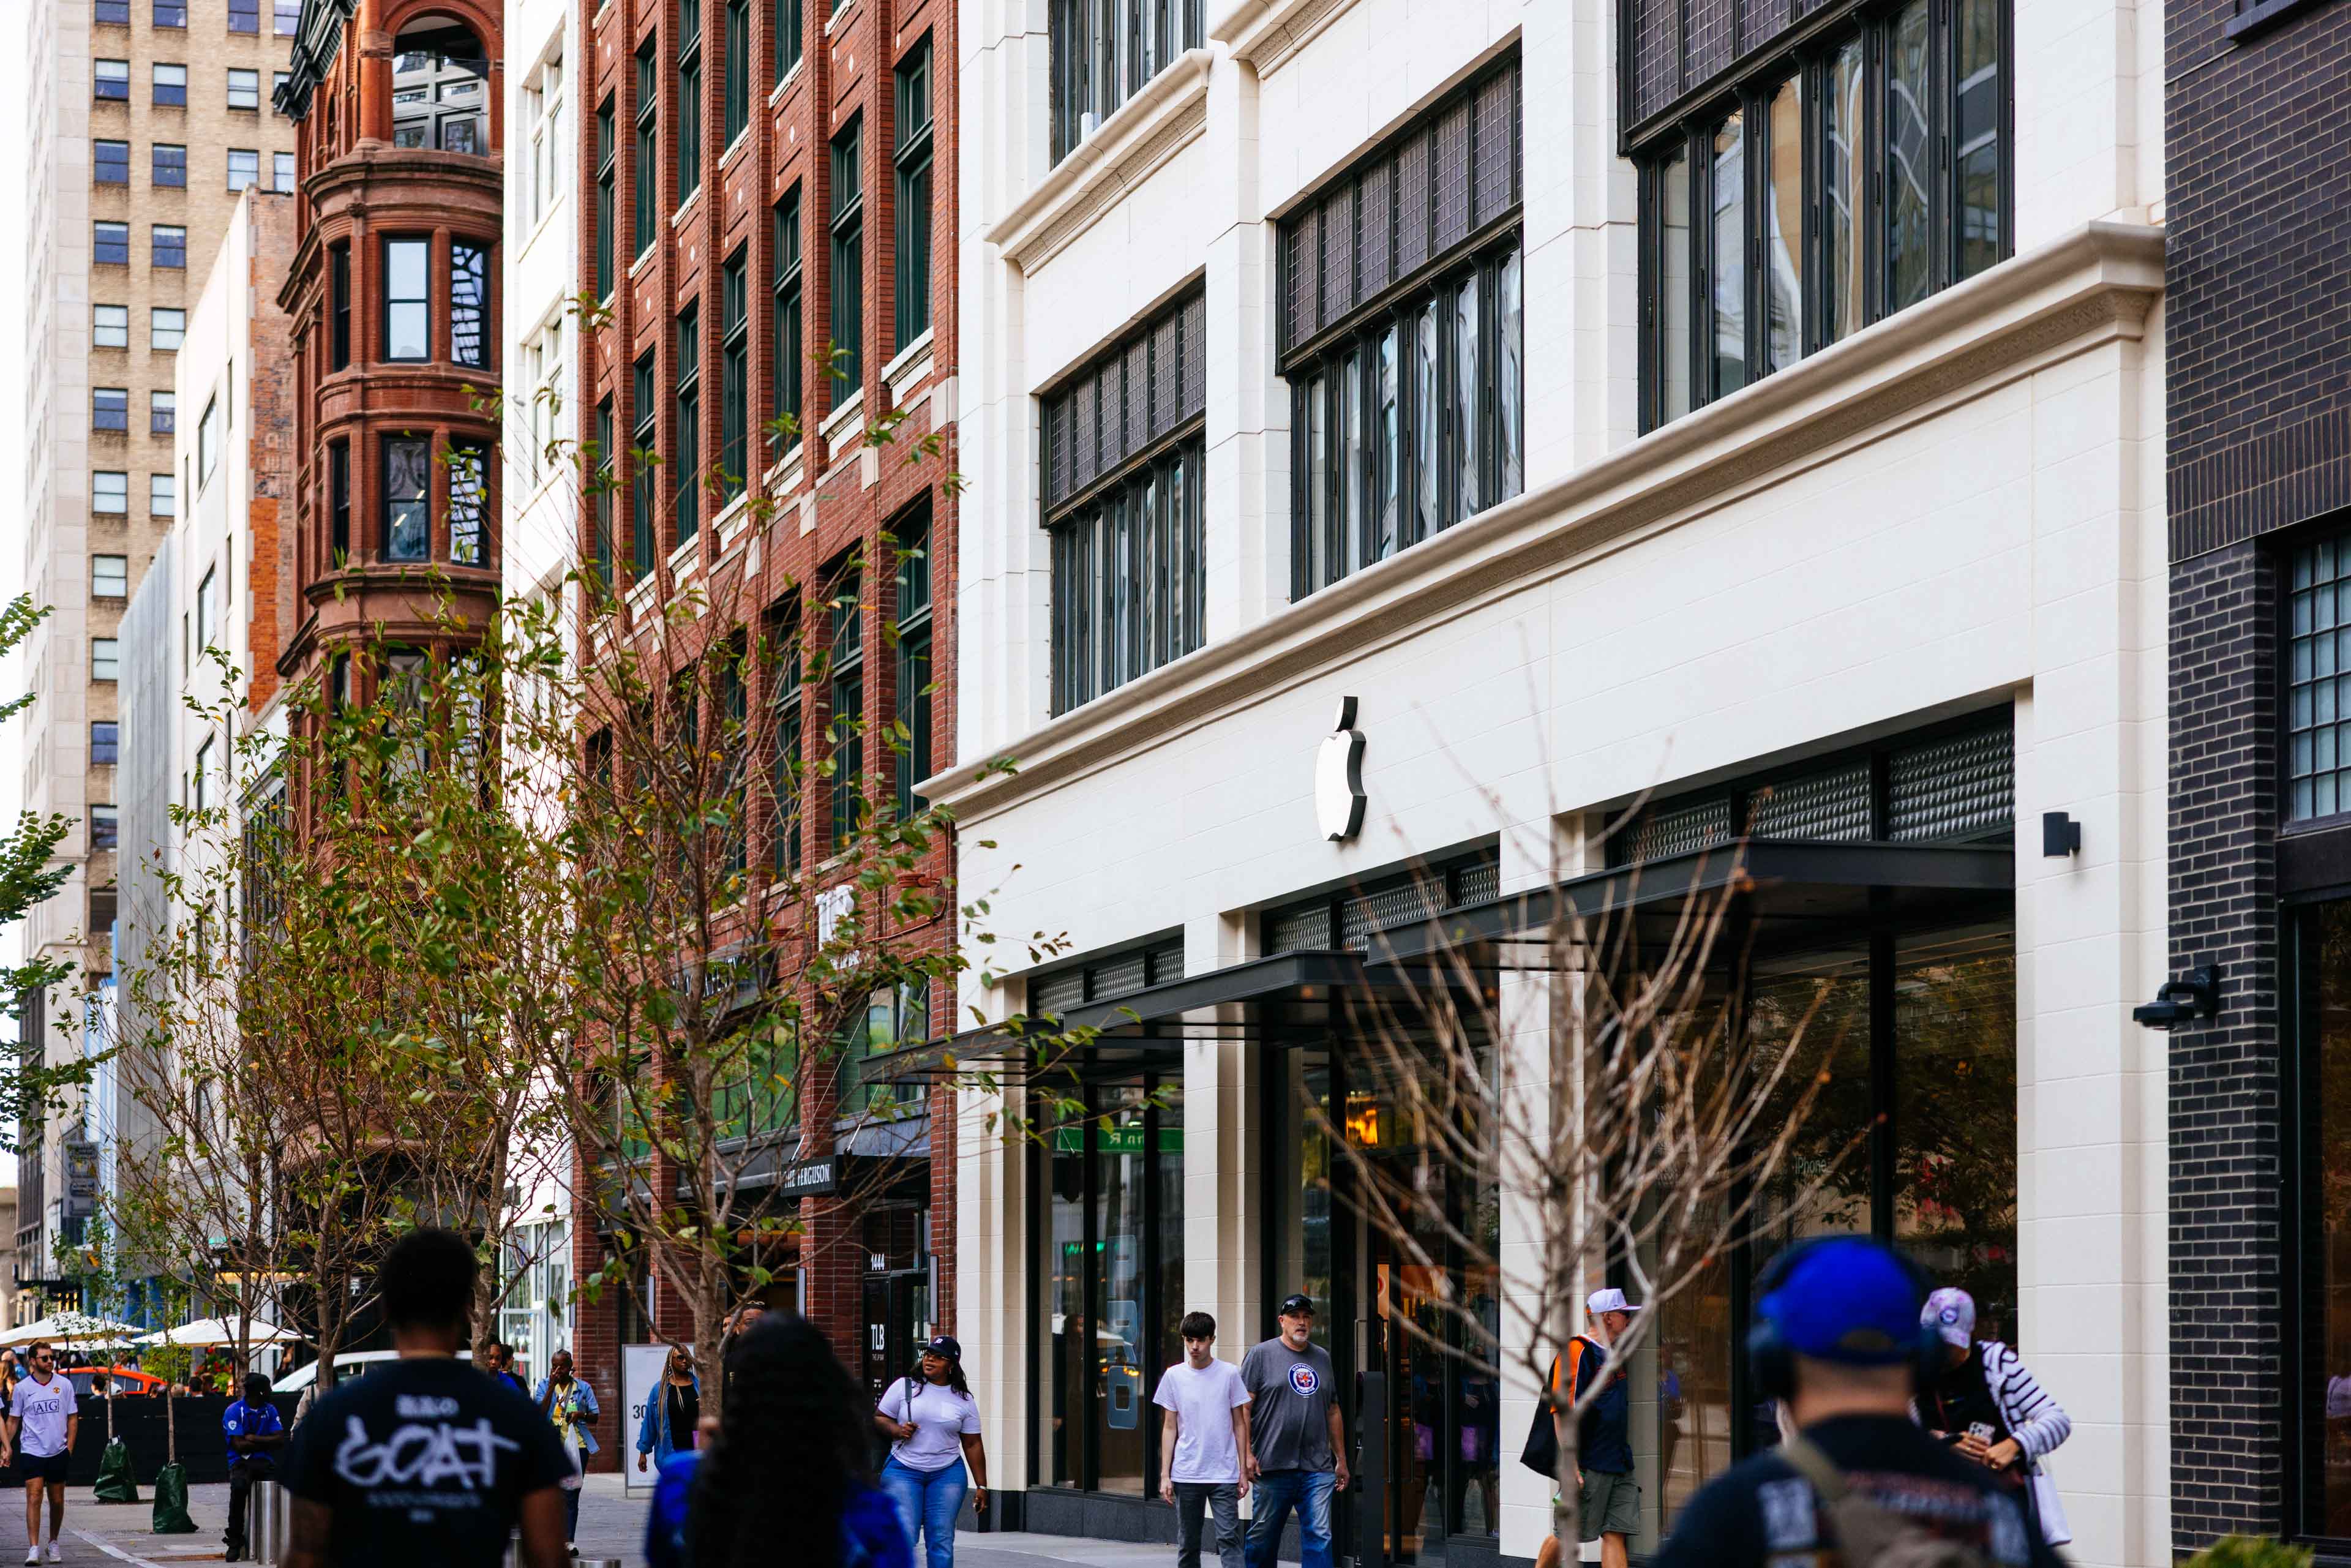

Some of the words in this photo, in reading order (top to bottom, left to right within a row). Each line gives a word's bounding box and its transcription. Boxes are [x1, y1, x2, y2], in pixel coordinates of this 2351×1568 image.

[797, 1164, 831, 1186] FERGUSON
[1794, 1155, 1827, 1175] iPhone
[871, 1253, 885, 1271] 1444
[871, 1324, 885, 1350] TLB
[36, 1401, 58, 1413] AIG
